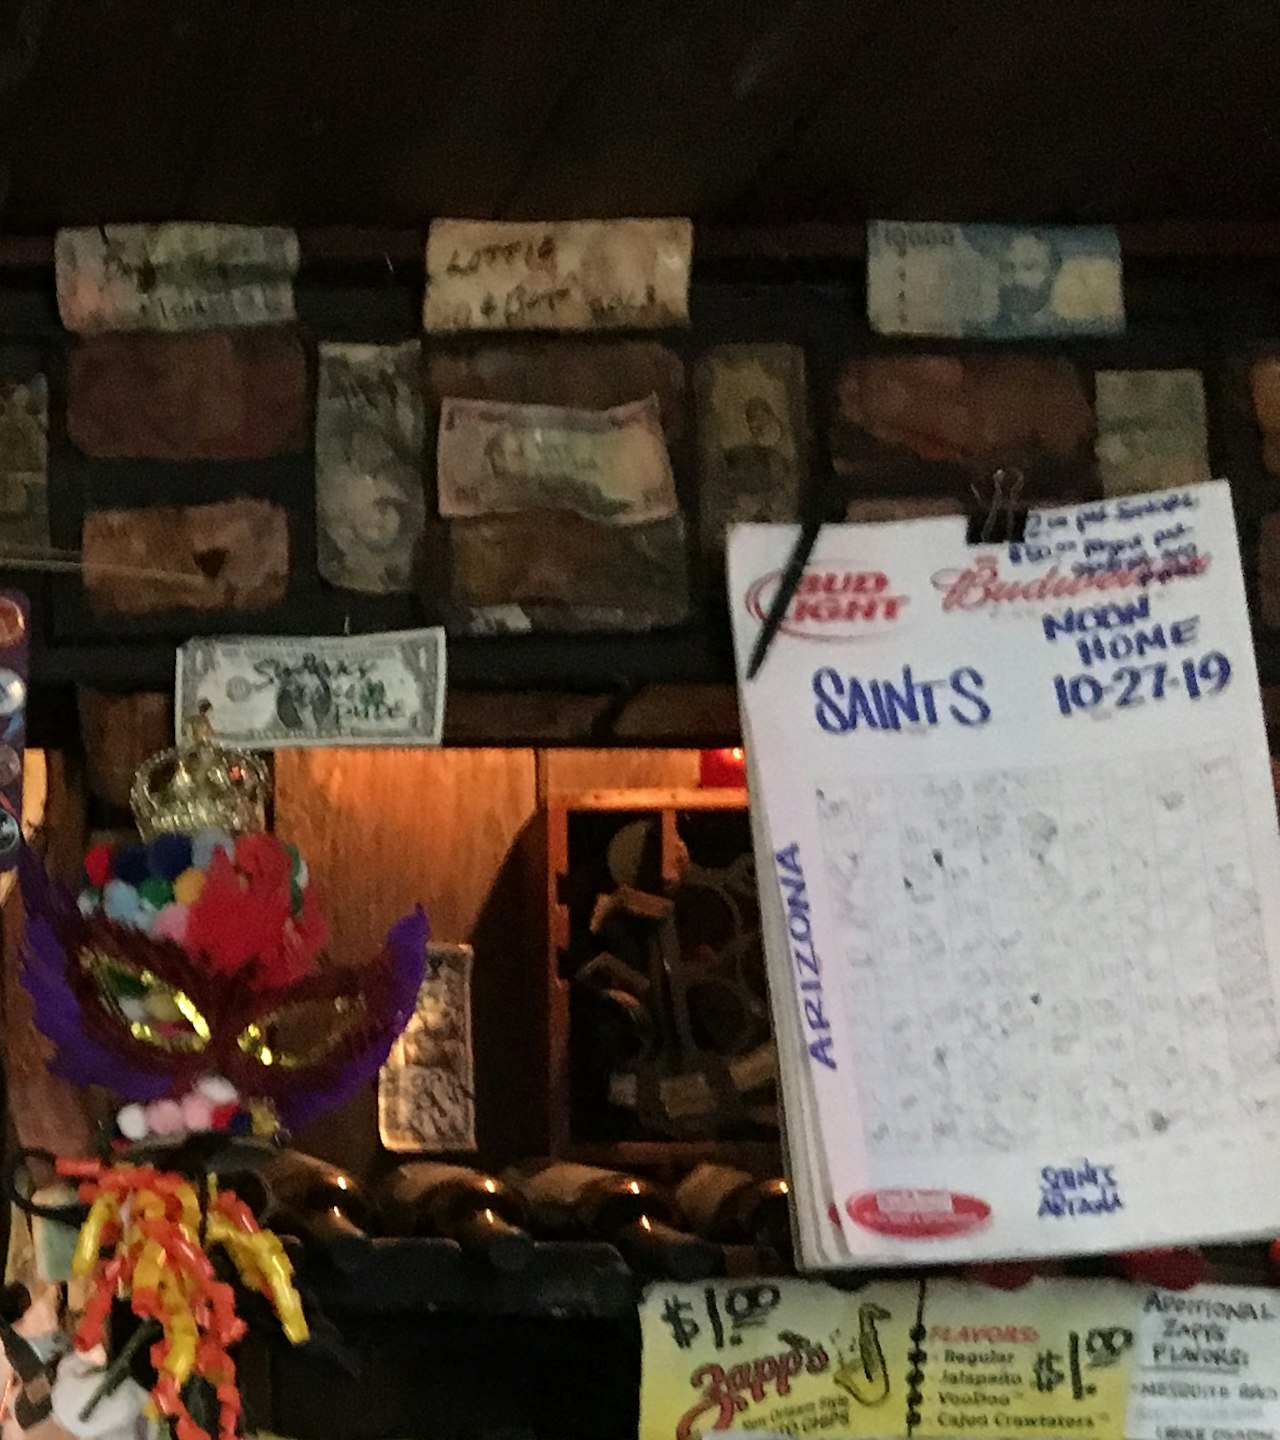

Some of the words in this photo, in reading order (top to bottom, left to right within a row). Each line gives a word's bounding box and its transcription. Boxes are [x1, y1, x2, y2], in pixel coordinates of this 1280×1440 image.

[1041, 595, 1151, 641] NOON
[1077, 614, 1201, 667] HOME
[811, 663, 992, 735] SAINTS
[1053, 650, 1233, 717] 10-27-19
[775, 843, 838, 1072] ARIZONA
[943, 1350, 1015, 1365] Regular
